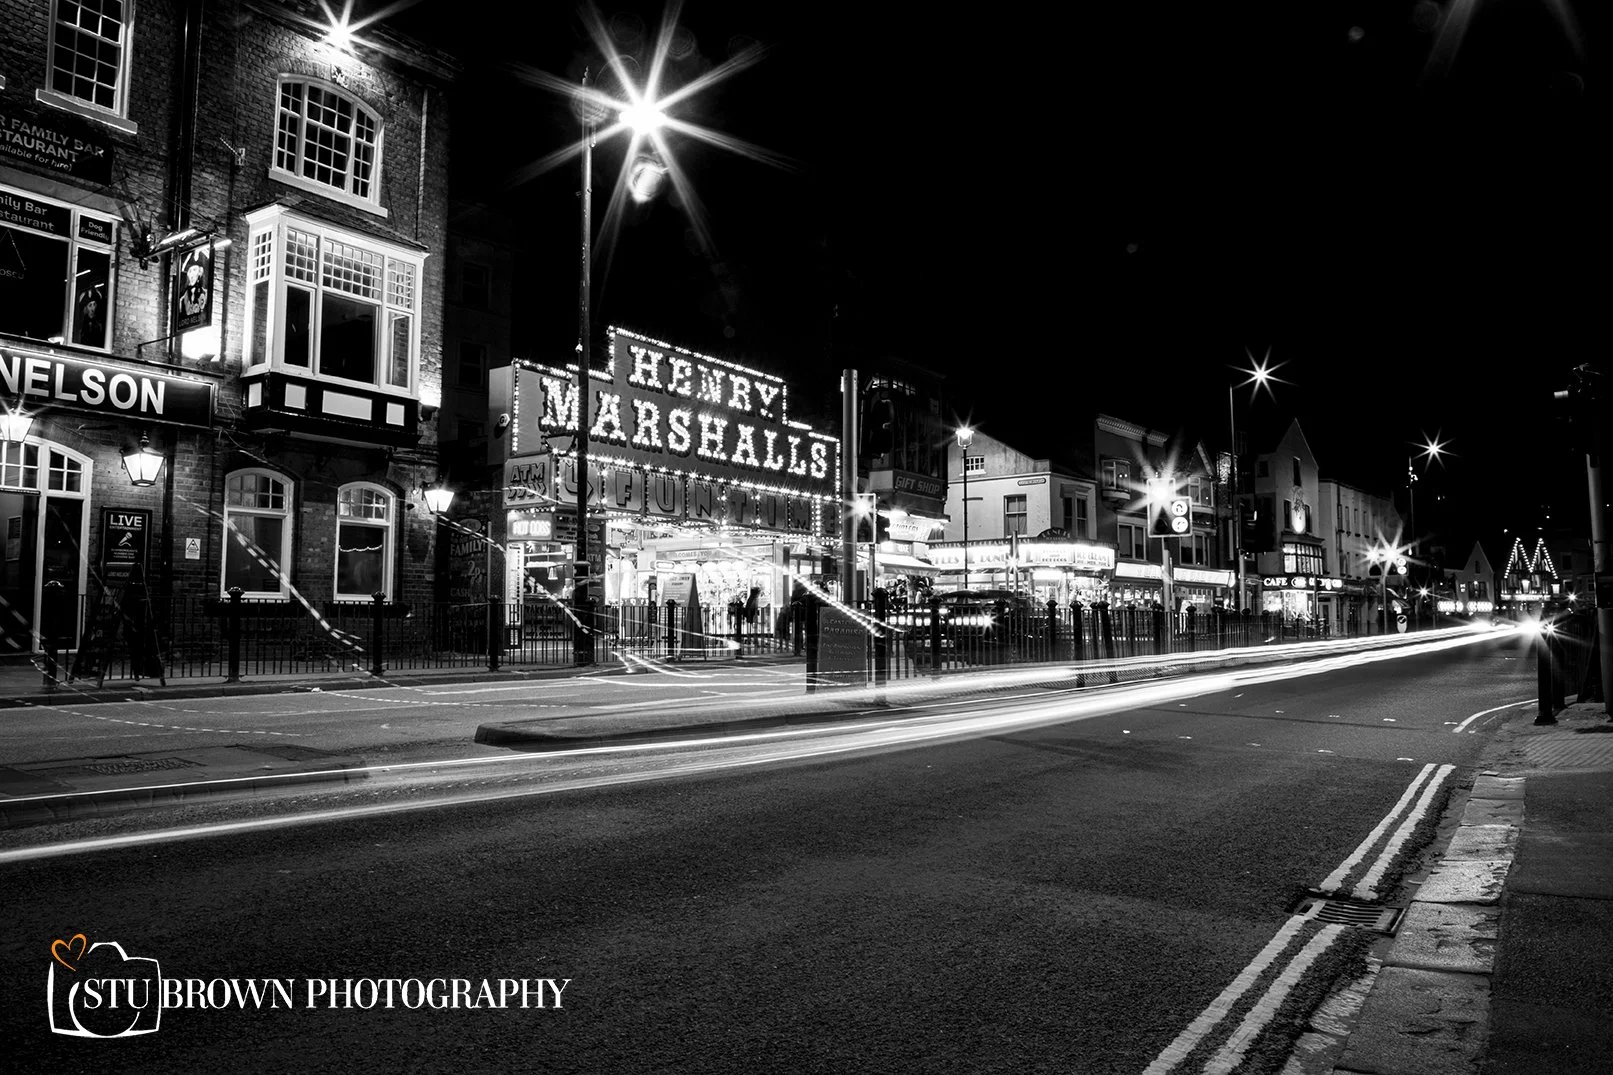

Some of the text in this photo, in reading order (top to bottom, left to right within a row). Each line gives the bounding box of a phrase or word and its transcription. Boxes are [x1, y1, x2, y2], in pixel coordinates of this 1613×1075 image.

[0, 129, 79, 162] TAURANT
[11, 118, 69, 146] FAMILY
[74, 139, 105, 158] BAR
[34, 153, 50, 164] for
[51, 157, 73, 172] hire)
[25, 201, 49, 216] Bar
[80, 226, 111, 242] Friendly
[88, 221, 104, 233] Dog
[0, 354, 166, 415] NELSON
[628, 344, 779, 421] HENRY
[540, 375, 828, 479] MARSHALLS
[510, 462, 545, 484] ATM
[895, 476, 942, 495] GIFT SHOP
[110, 514, 143, 527] LIVE
[1264, 578, 1288, 587] CAFE
